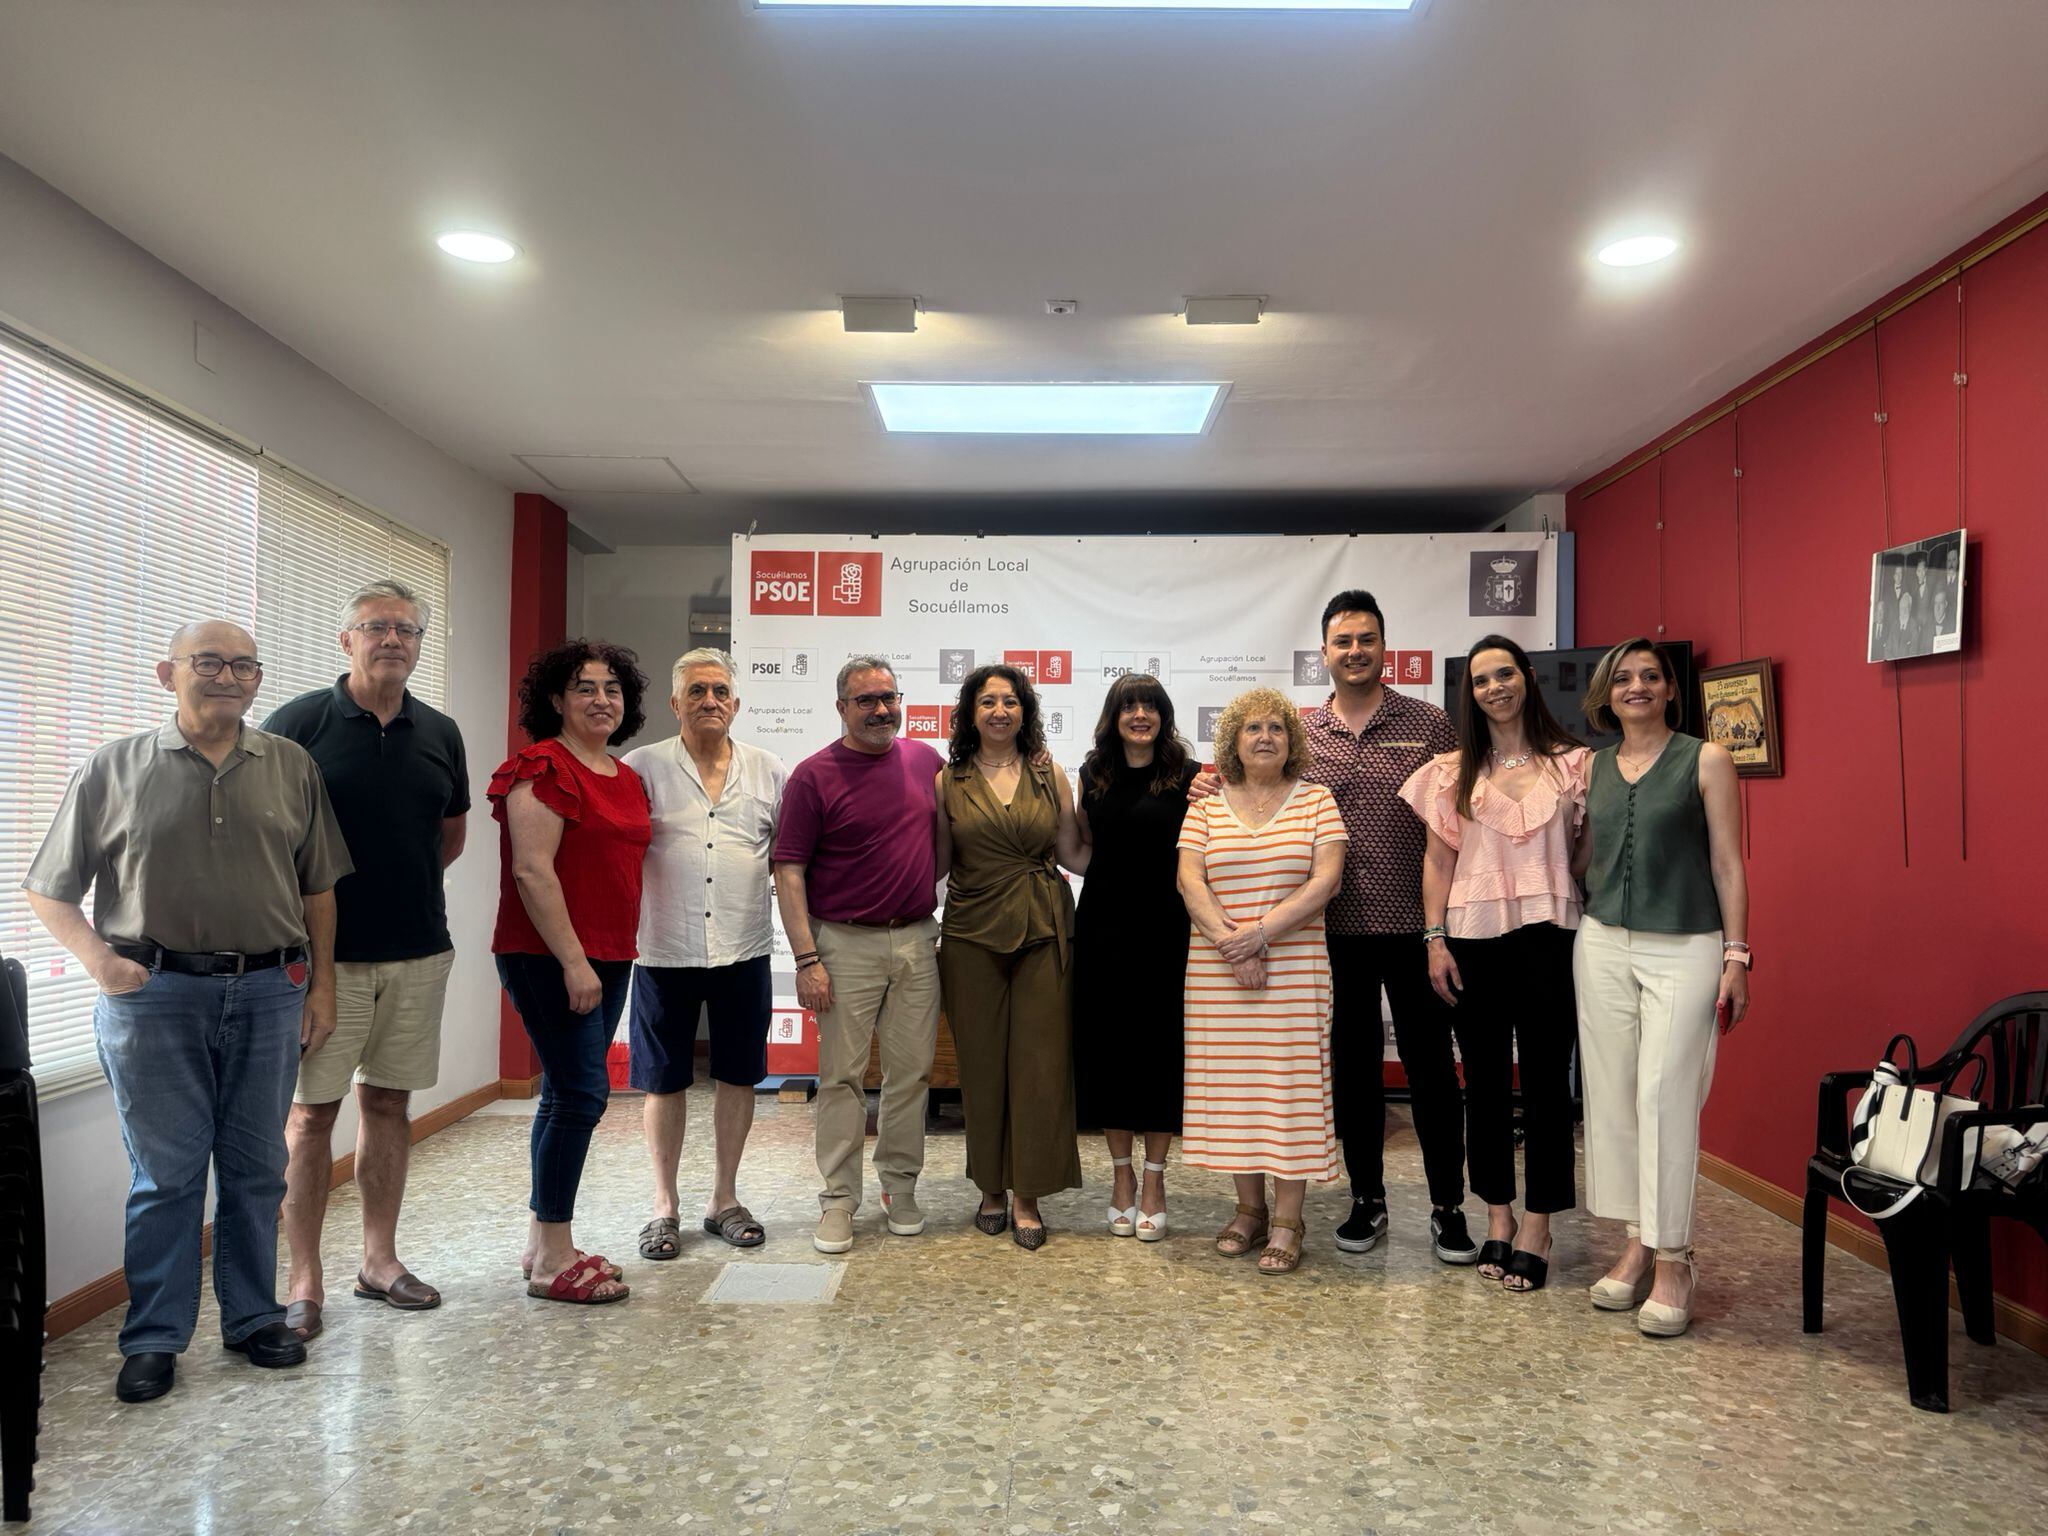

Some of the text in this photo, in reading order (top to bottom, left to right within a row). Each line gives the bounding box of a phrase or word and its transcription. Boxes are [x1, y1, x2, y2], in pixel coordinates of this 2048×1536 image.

[890, 556, 1029, 574] Agrupación Local
[755, 570, 808, 580] Socuéllamos
[949, 578, 969, 592] de
[755, 581, 811, 602] PSOE
[908, 599, 1010, 614] Socuéllamos
[891, 653, 912, 661] Local
[1199, 655, 1244, 664] Agrupación
[752, 663, 781, 674] PSOE
[1228, 664, 1238, 672] de
[1208, 674, 1257, 683] Socuéllamos
[748, 706, 814, 716] Agrupación Local
[756, 725, 804, 735] Socuéllamos
[908, 722, 938, 732] PSOE
